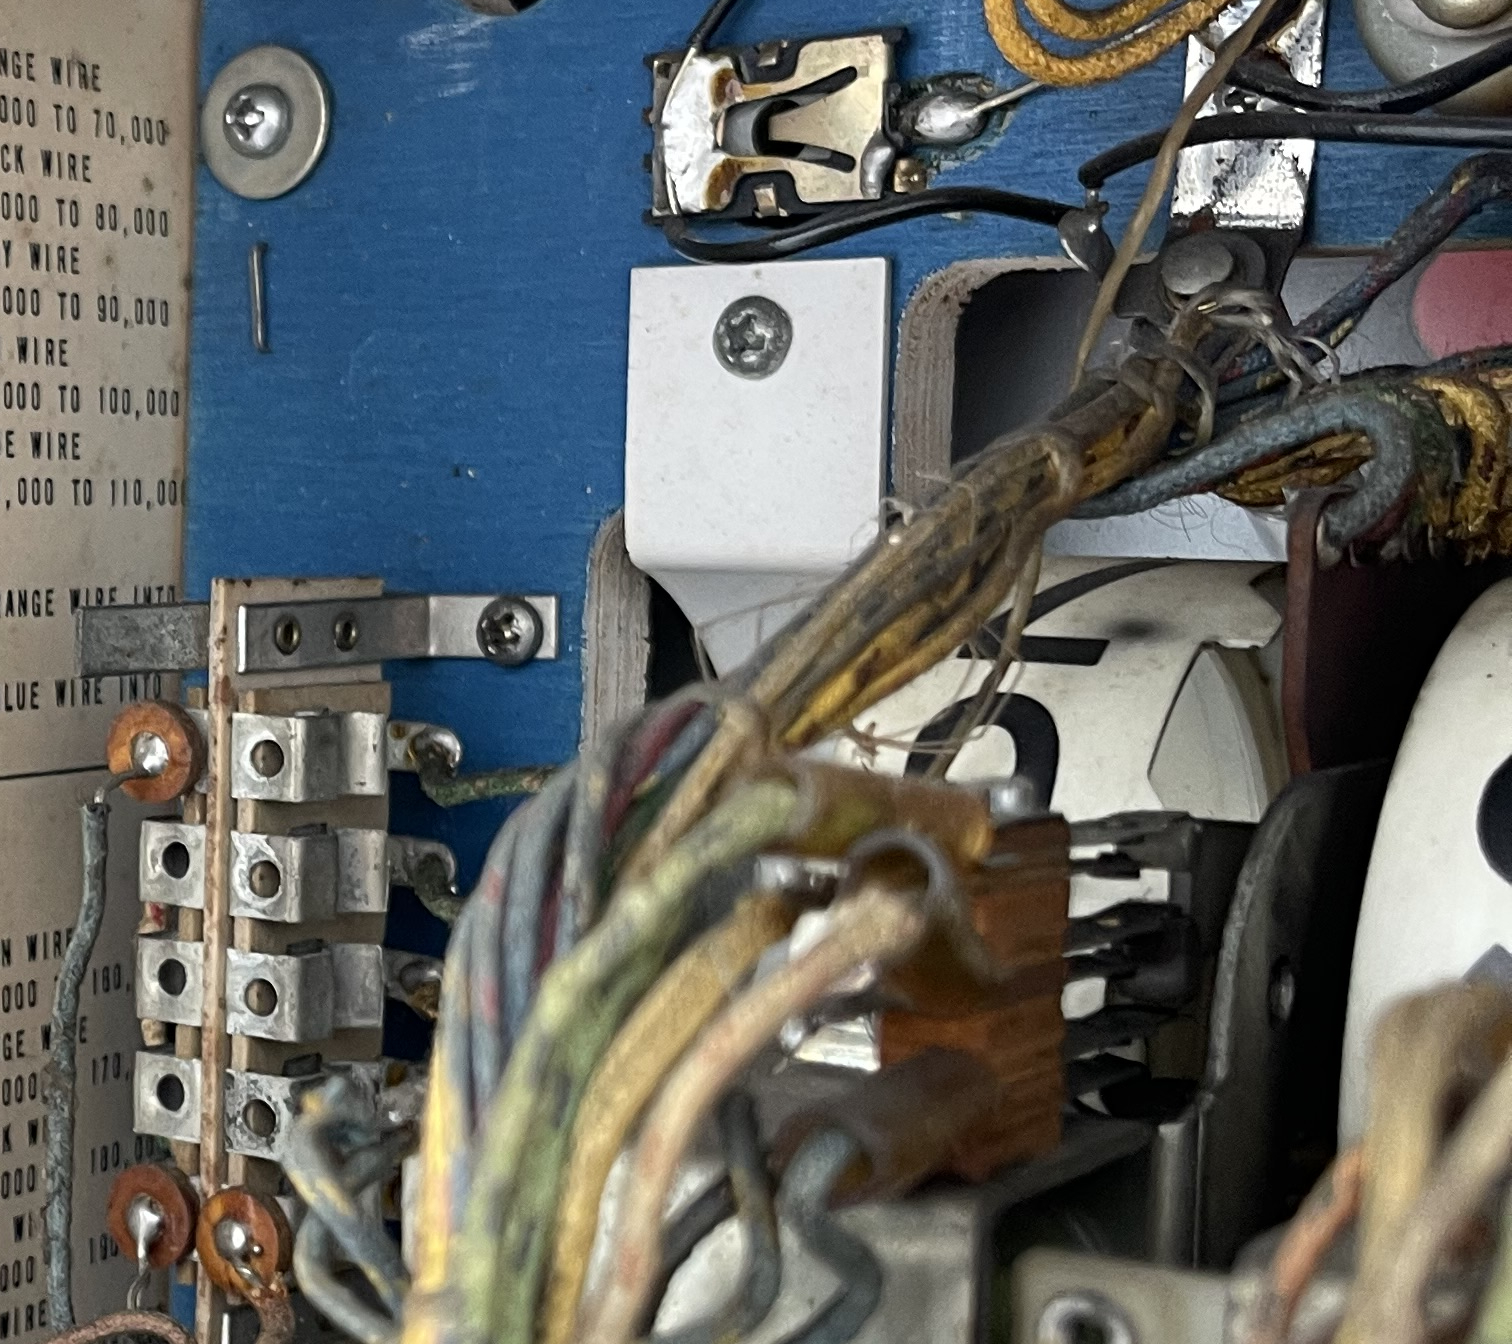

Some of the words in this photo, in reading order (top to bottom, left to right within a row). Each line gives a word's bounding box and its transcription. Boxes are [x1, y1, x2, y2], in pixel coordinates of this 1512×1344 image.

[50, 55, 102, 93] WIRE
[52, 103, 77, 135] TO
[93, 108, 171, 147] 70,000
[40, 149, 92, 184] WIRE
[28, 241, 81, 275] WIRE
[57, 384, 81, 414] TO
[99, 386, 180, 421] 100,000
[29, 431, 81, 461] WIRE
[54, 677, 105, 709] WIRE
